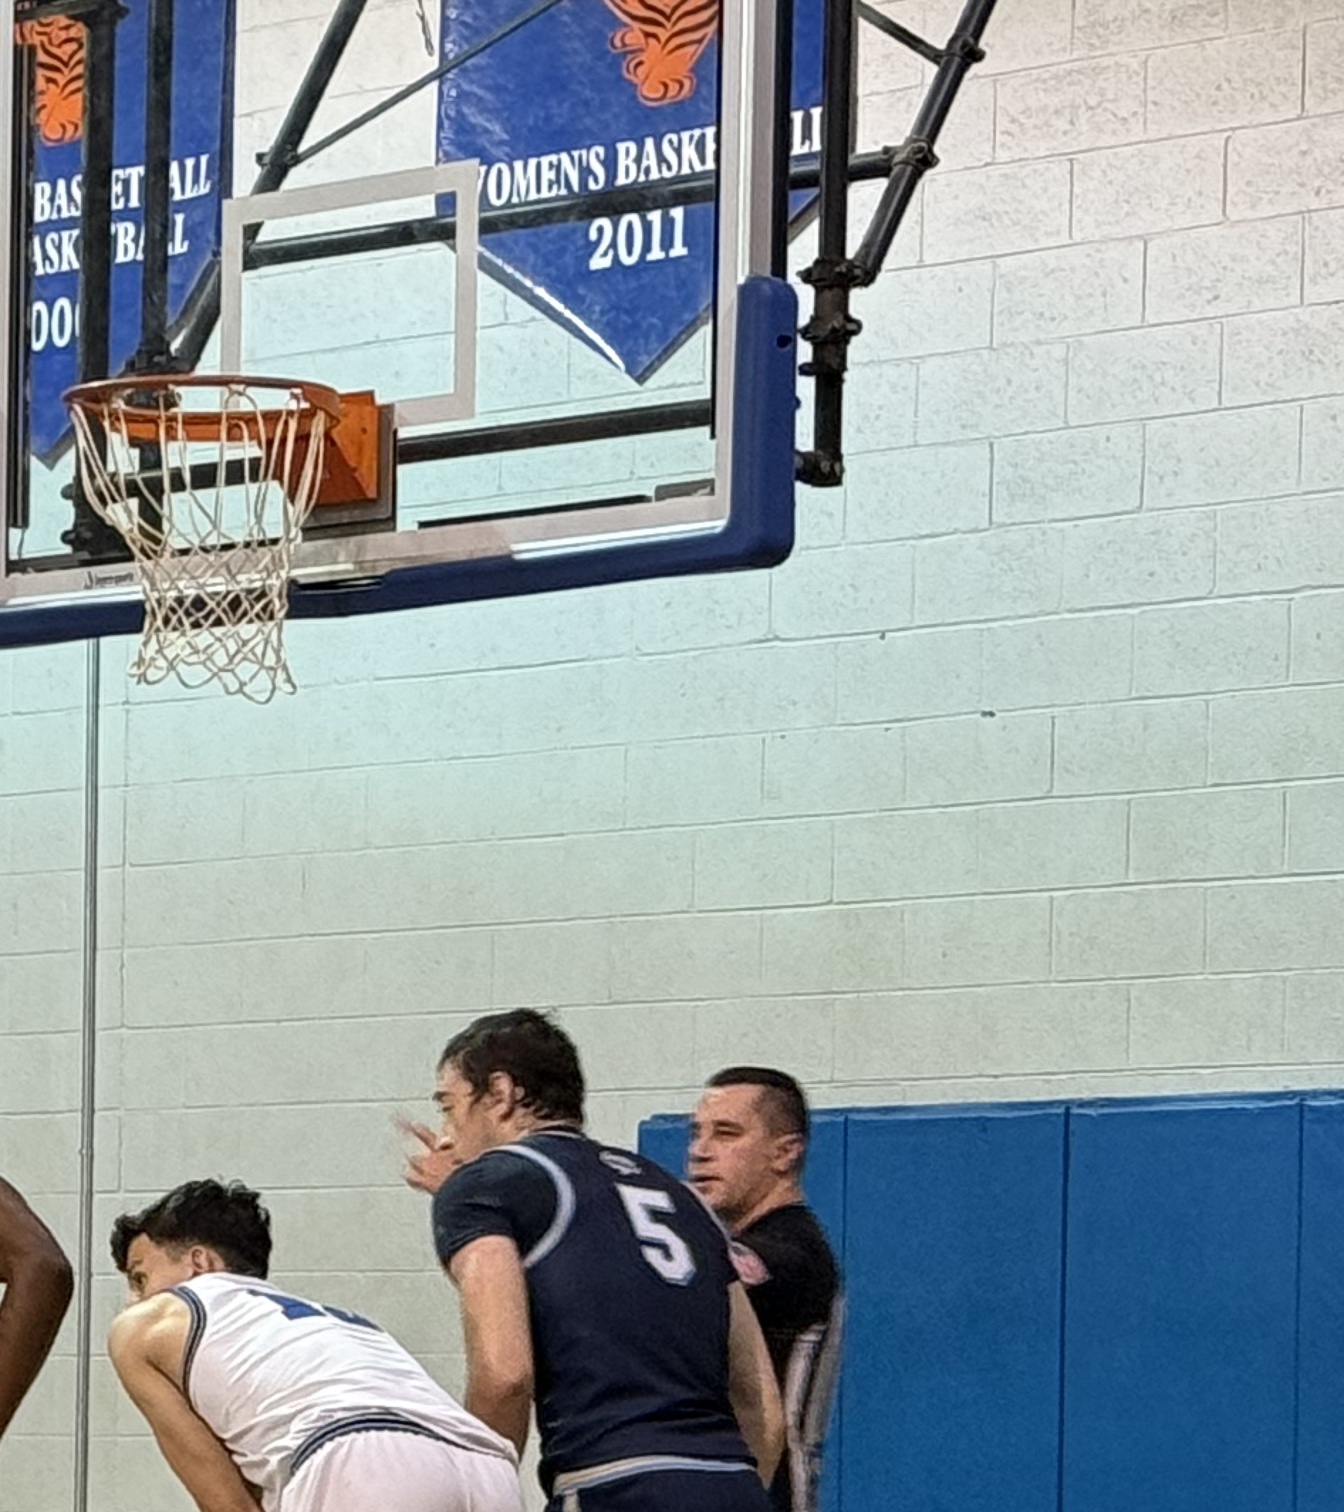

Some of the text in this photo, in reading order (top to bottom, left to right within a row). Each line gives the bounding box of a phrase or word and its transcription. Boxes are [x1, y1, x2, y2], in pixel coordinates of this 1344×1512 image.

[476, 145, 605, 207] OMEN'S
[589, 207, 688, 270] 2011
[617, 1183, 697, 1287] 5
